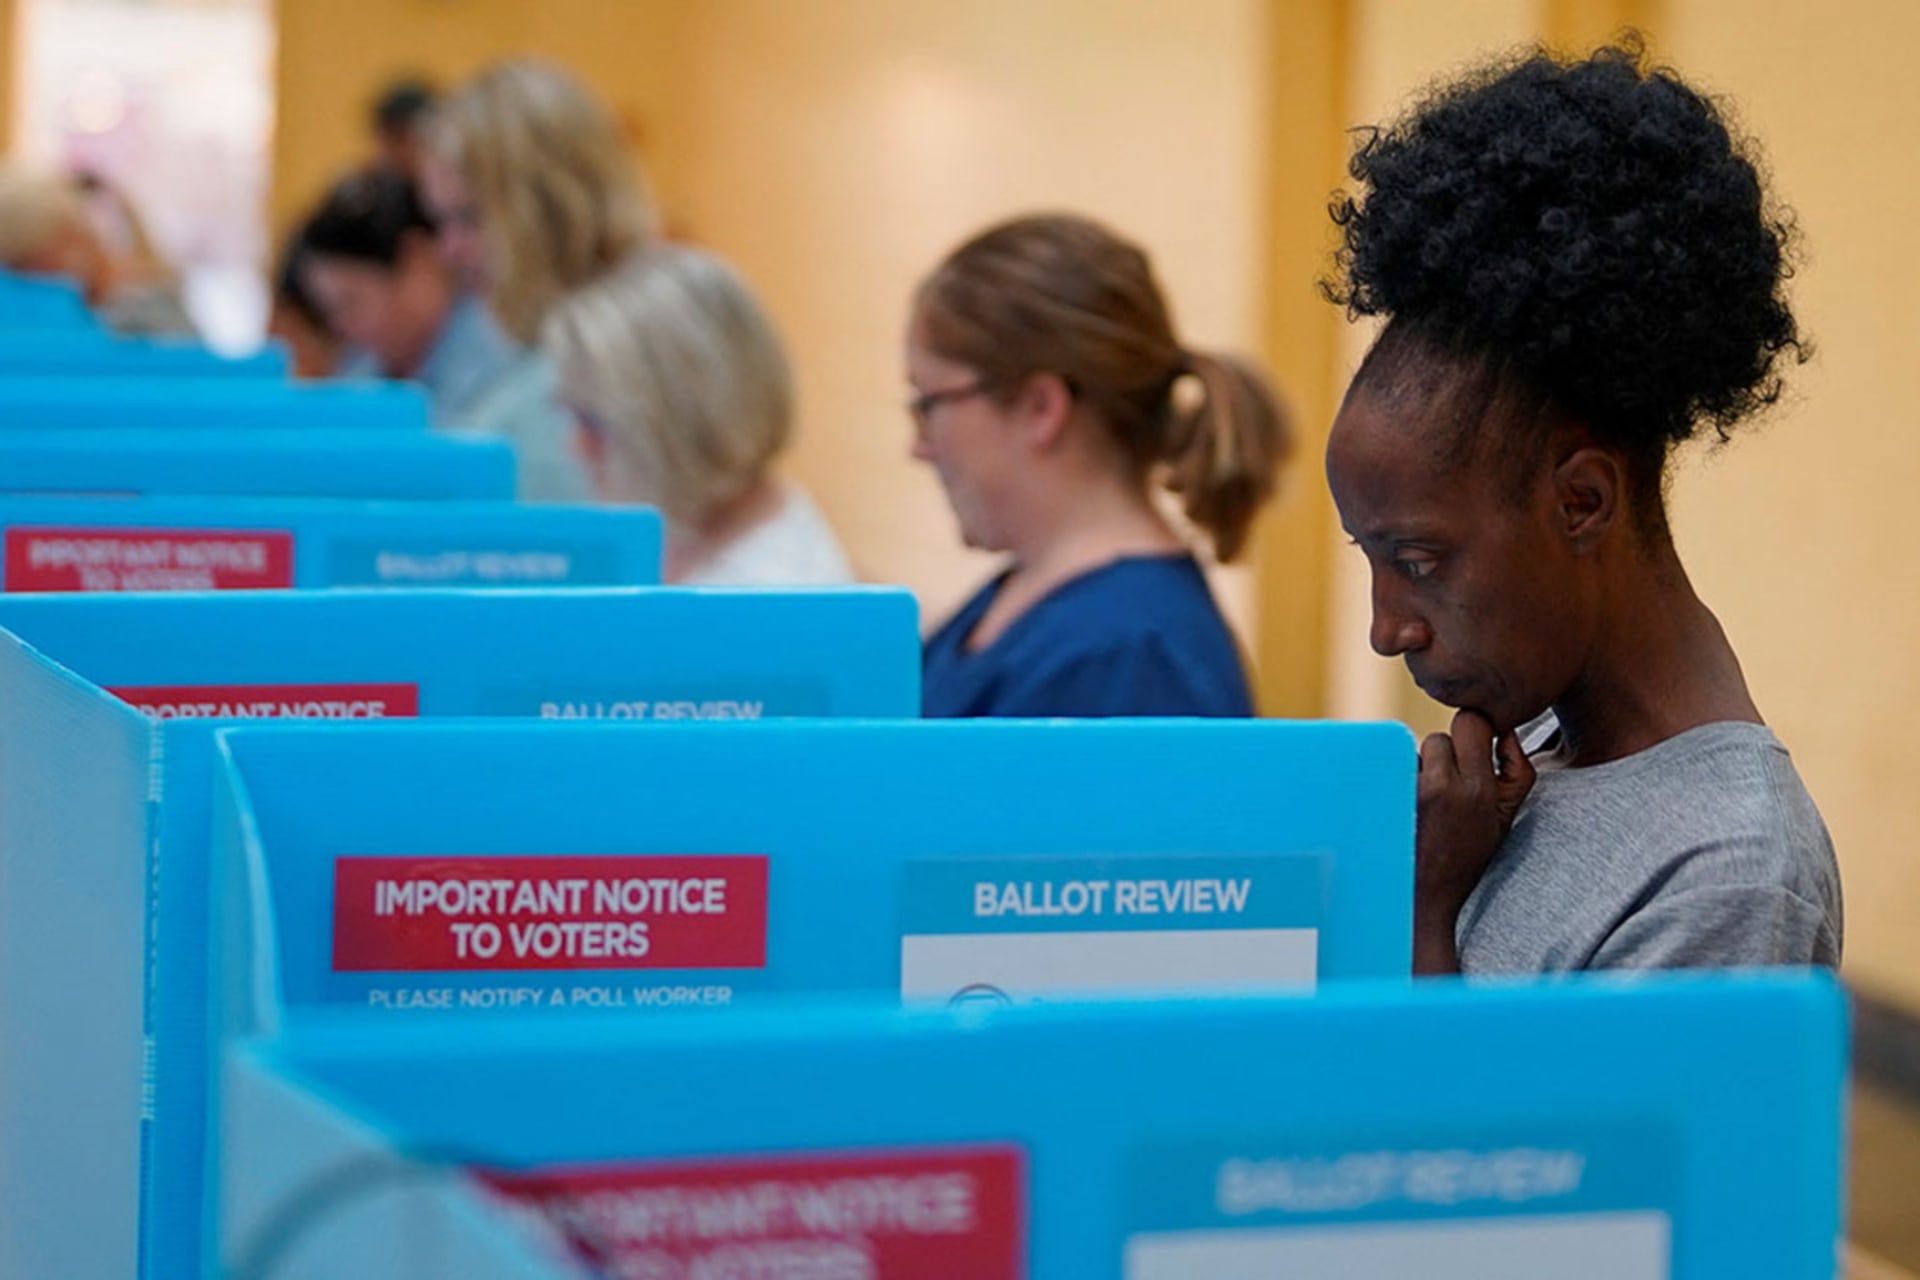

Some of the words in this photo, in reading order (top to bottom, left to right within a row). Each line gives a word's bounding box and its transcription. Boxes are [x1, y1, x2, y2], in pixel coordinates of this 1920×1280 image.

[137, 701, 277, 718] PORTANT
[375, 879, 587, 915] IMPORTANT
[594, 878, 726, 913] NOTICE
[973, 881, 1108, 917] BALLOT
[1113, 878, 1251, 914] REVIEW
[450, 923, 502, 958] TO
[508, 922, 649, 957] VOTERS
[369, 988, 453, 1009] PLEASE
[460, 988, 544, 1007] NOTIFY
[549, 988, 567, 1006] A
[571, 986, 627, 1006] POLL
[633, 985, 733, 1005] WORKER
